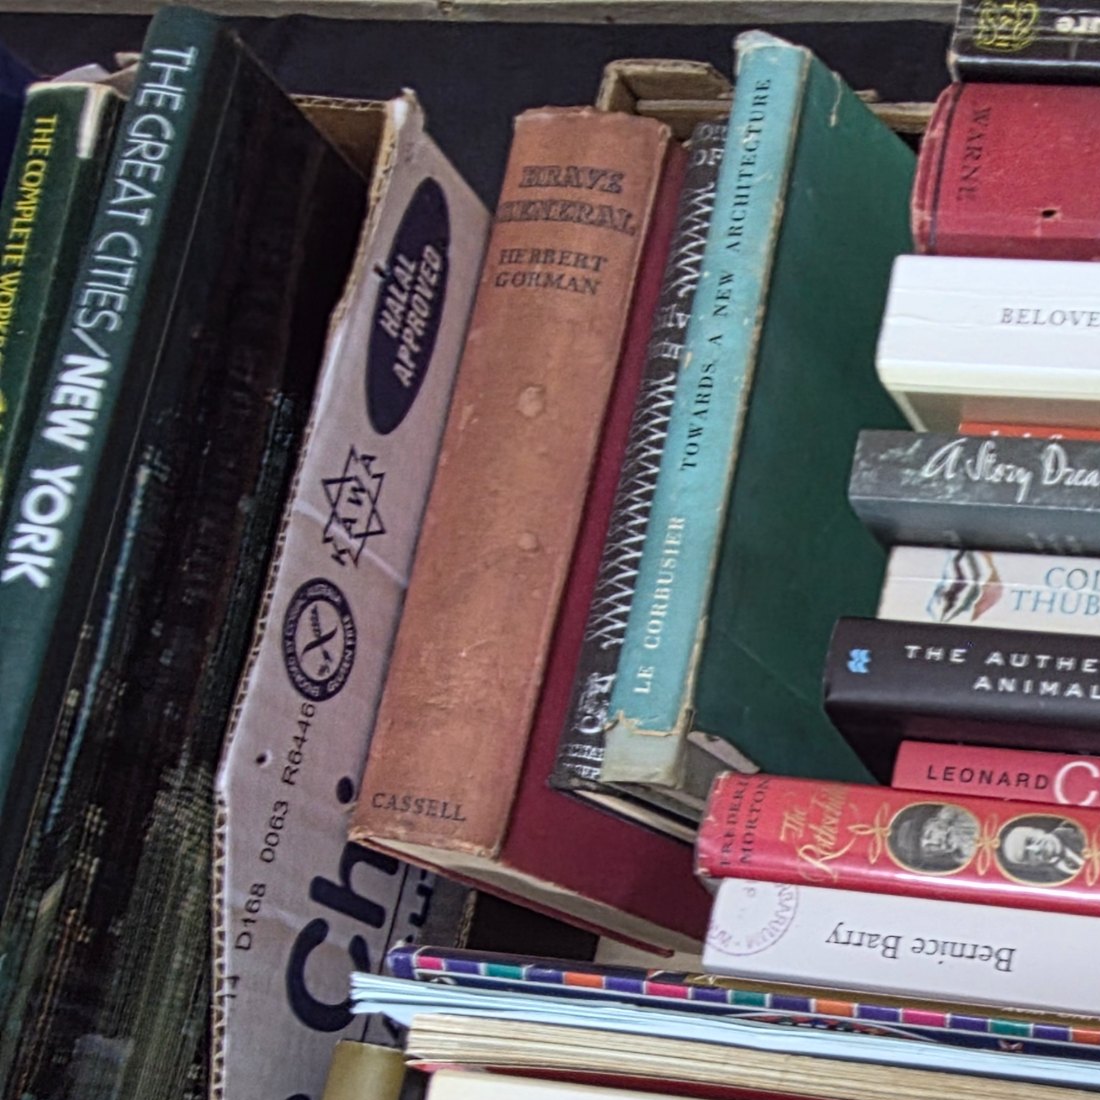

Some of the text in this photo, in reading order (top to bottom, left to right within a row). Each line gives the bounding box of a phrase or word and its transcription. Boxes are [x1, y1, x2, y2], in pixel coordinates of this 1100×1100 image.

[136, 47, 197, 110] THE
[106, 114, 176, 225] GREAT
[519, 165, 626, 194] BRAVE
[956, 106, 992, 202] WARNE
[2, 114, 58, 267] THE COMPLETE
[498, 200, 639, 236] GENERAL
[495, 271, 601, 295] GORMAN
[498, 248, 607, 272] HERBERT
[679, 79, 772, 472] TOWARDS A NEW ARCHITECTURE
[379, 254, 416, 337] HALAL
[393, 245, 443, 387] APPROVED
[921, 437, 968, 480] A
[965, 440, 1034, 503] Story
[0, 465, 82, 588] YORK
[633, 516, 686, 695] LE CORBUSIER
[904, 644, 968, 664] THE
[372, 792, 466, 822] CASSELL
[926, 765, 1050, 790] LEONARD
[825, 921, 1016, 974] Bernice Barry
